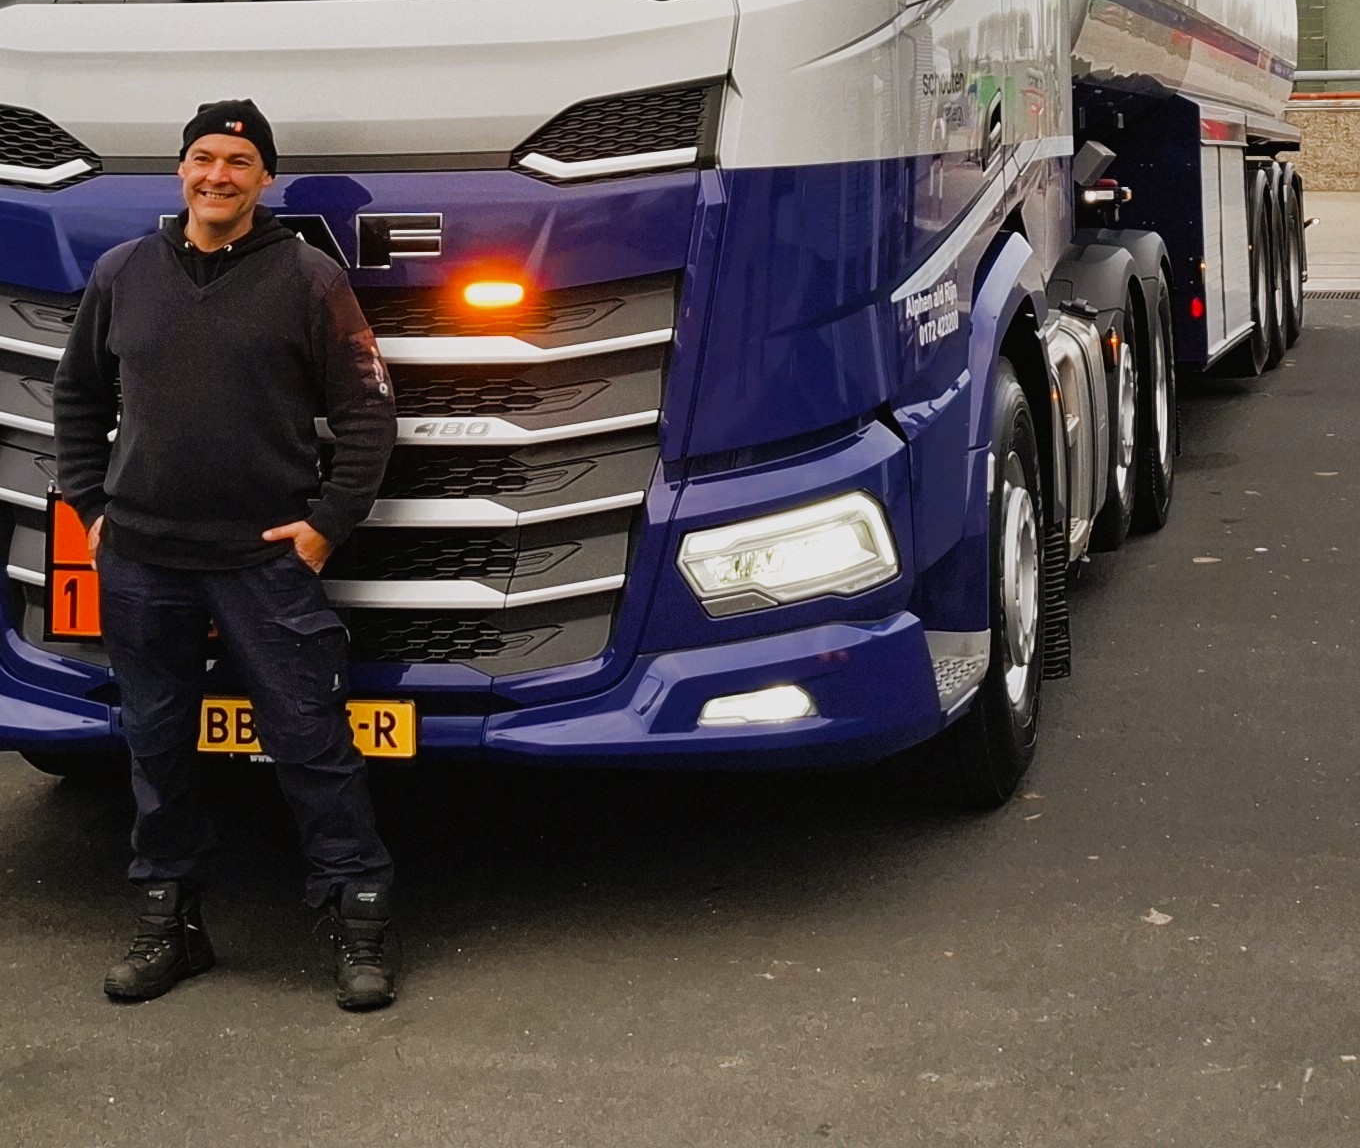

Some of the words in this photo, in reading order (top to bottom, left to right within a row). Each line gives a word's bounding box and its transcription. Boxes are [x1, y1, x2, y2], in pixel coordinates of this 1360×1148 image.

[905, 292, 933, 321] Alphen
[919, 319, 937, 347] 0172
[414, 421, 491, 437] 480
